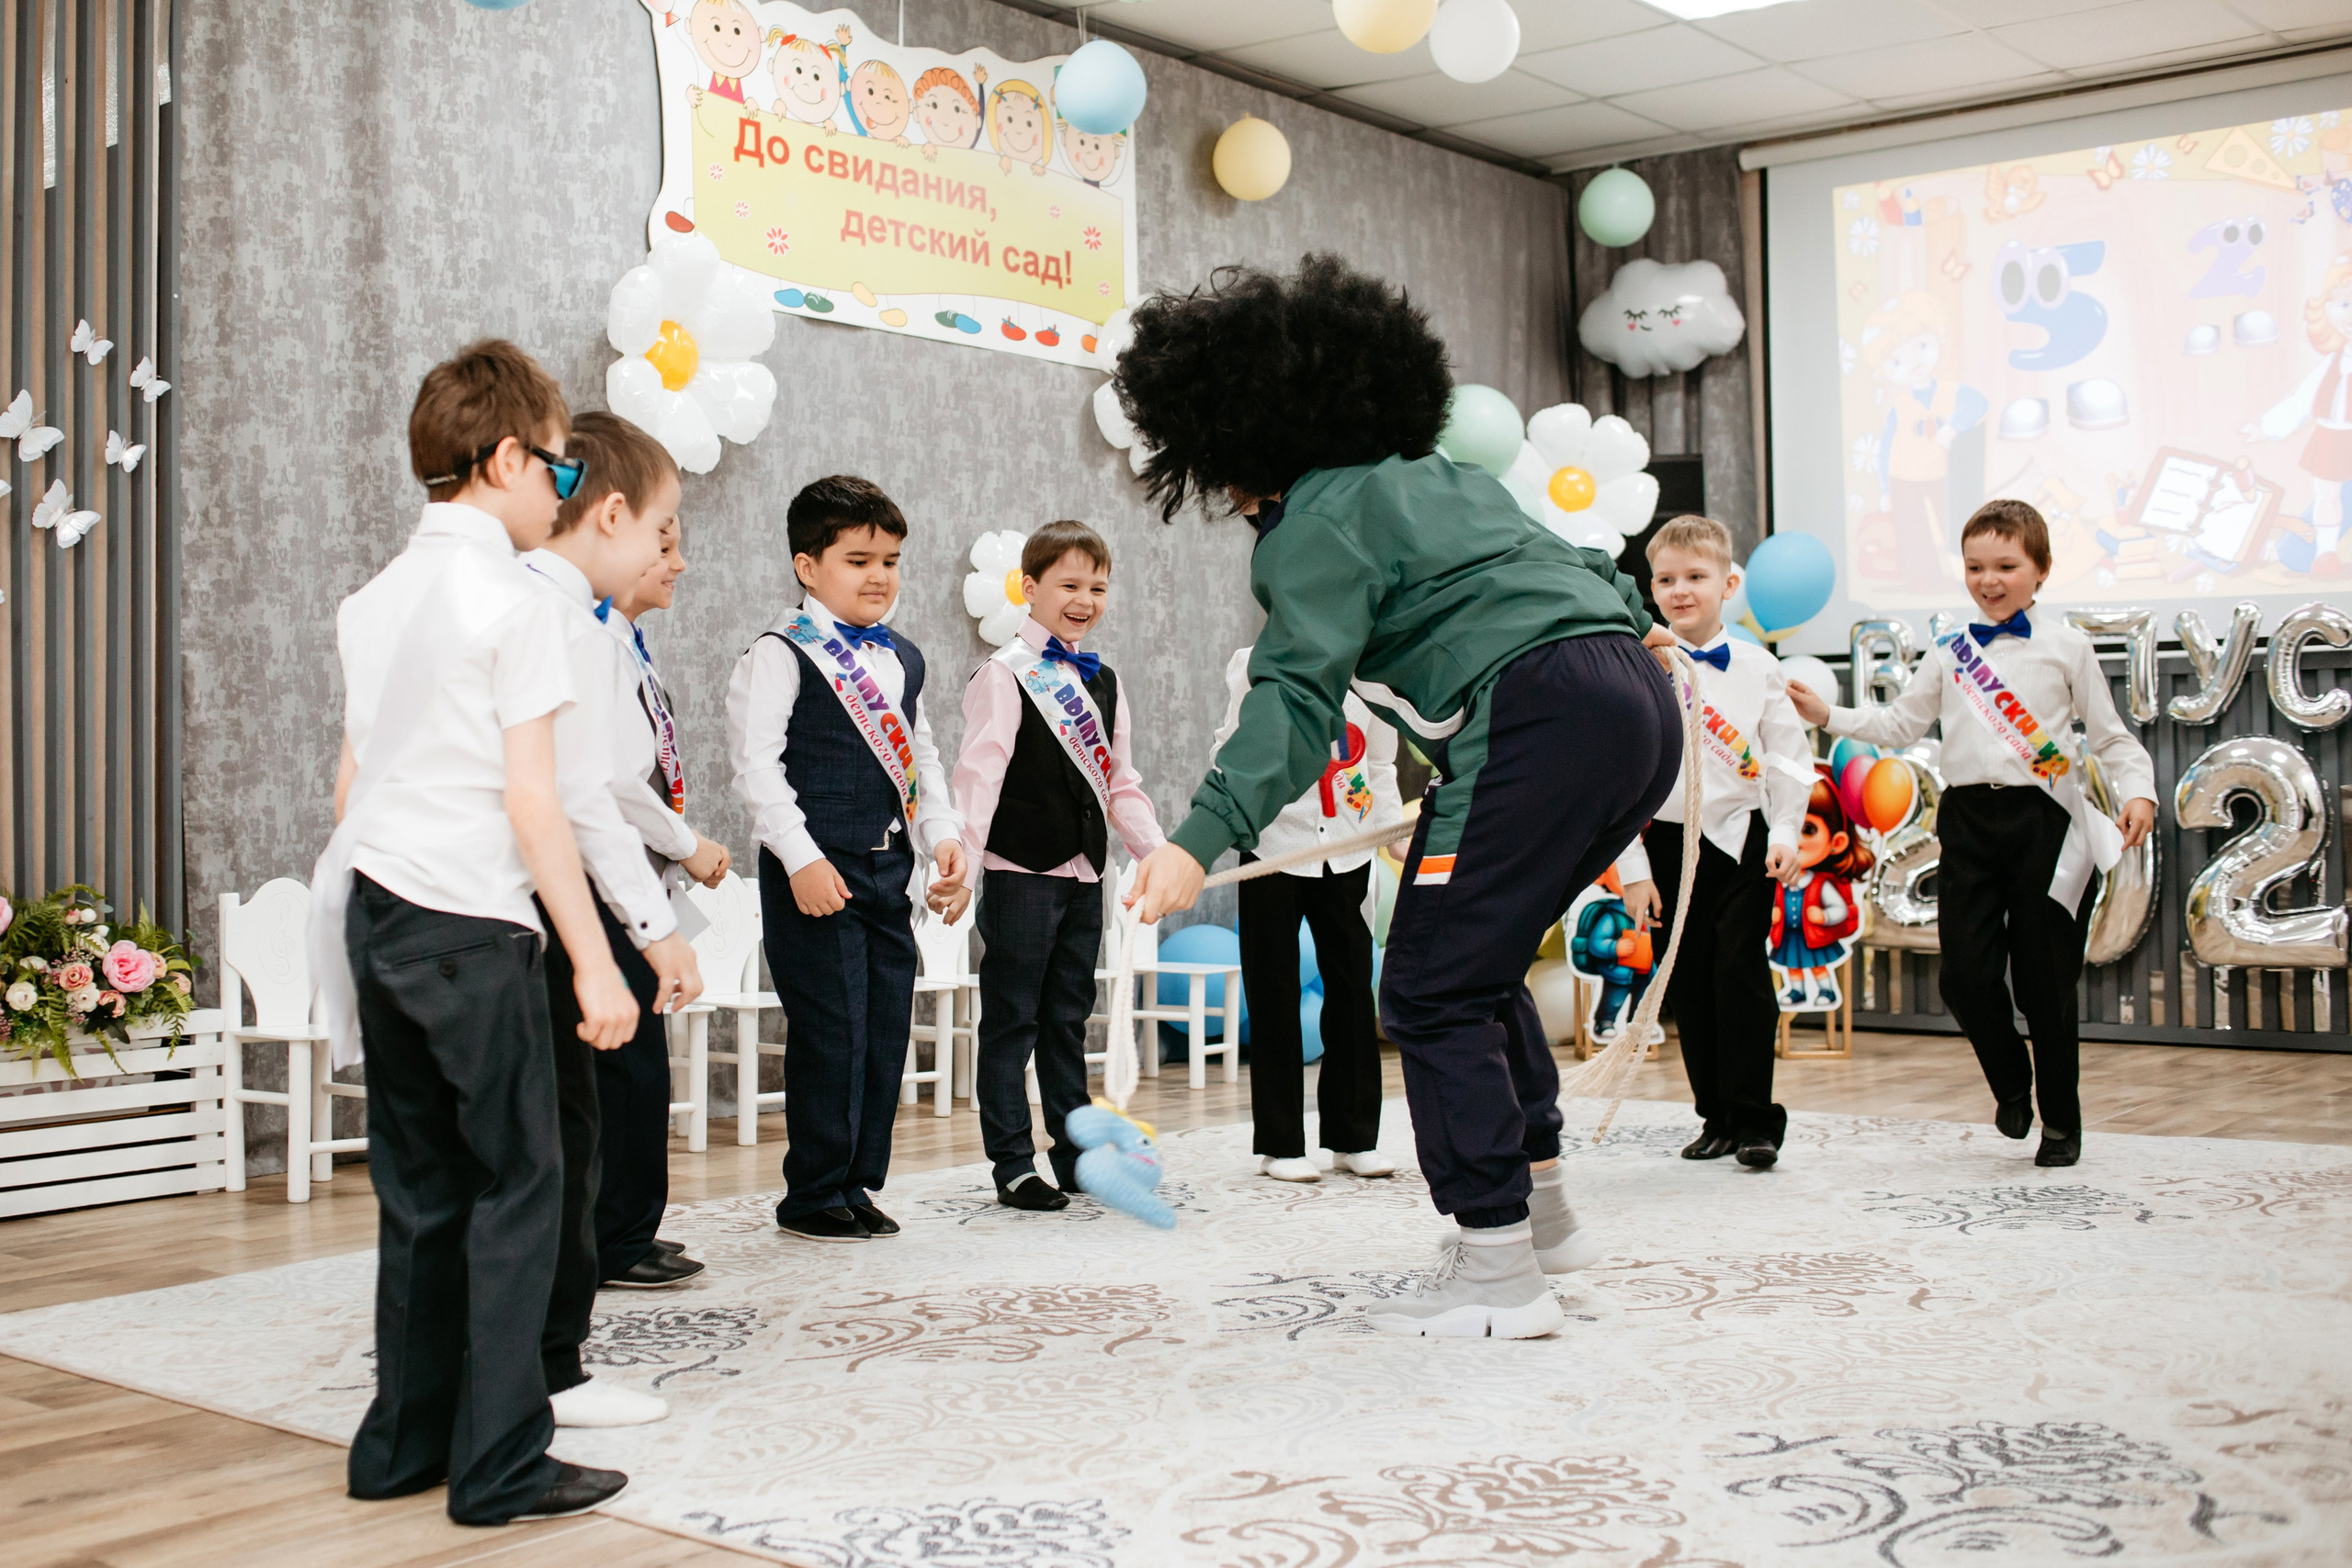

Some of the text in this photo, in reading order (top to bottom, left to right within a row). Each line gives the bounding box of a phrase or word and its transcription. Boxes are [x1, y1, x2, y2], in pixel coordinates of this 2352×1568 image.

[733, 117, 998, 222] До свидания,
[840, 208, 1073, 289] детский сад!
[845, 691, 908, 797] детского сада
[1053, 682, 1111, 790] ВЫПУСК
[1951, 633, 2060, 762] ВЫПУСКНИК
[1962, 682, 2032, 761] детского сада
[1069, 733, 1104, 788] детского
[1711, 745, 1736, 767] сада
